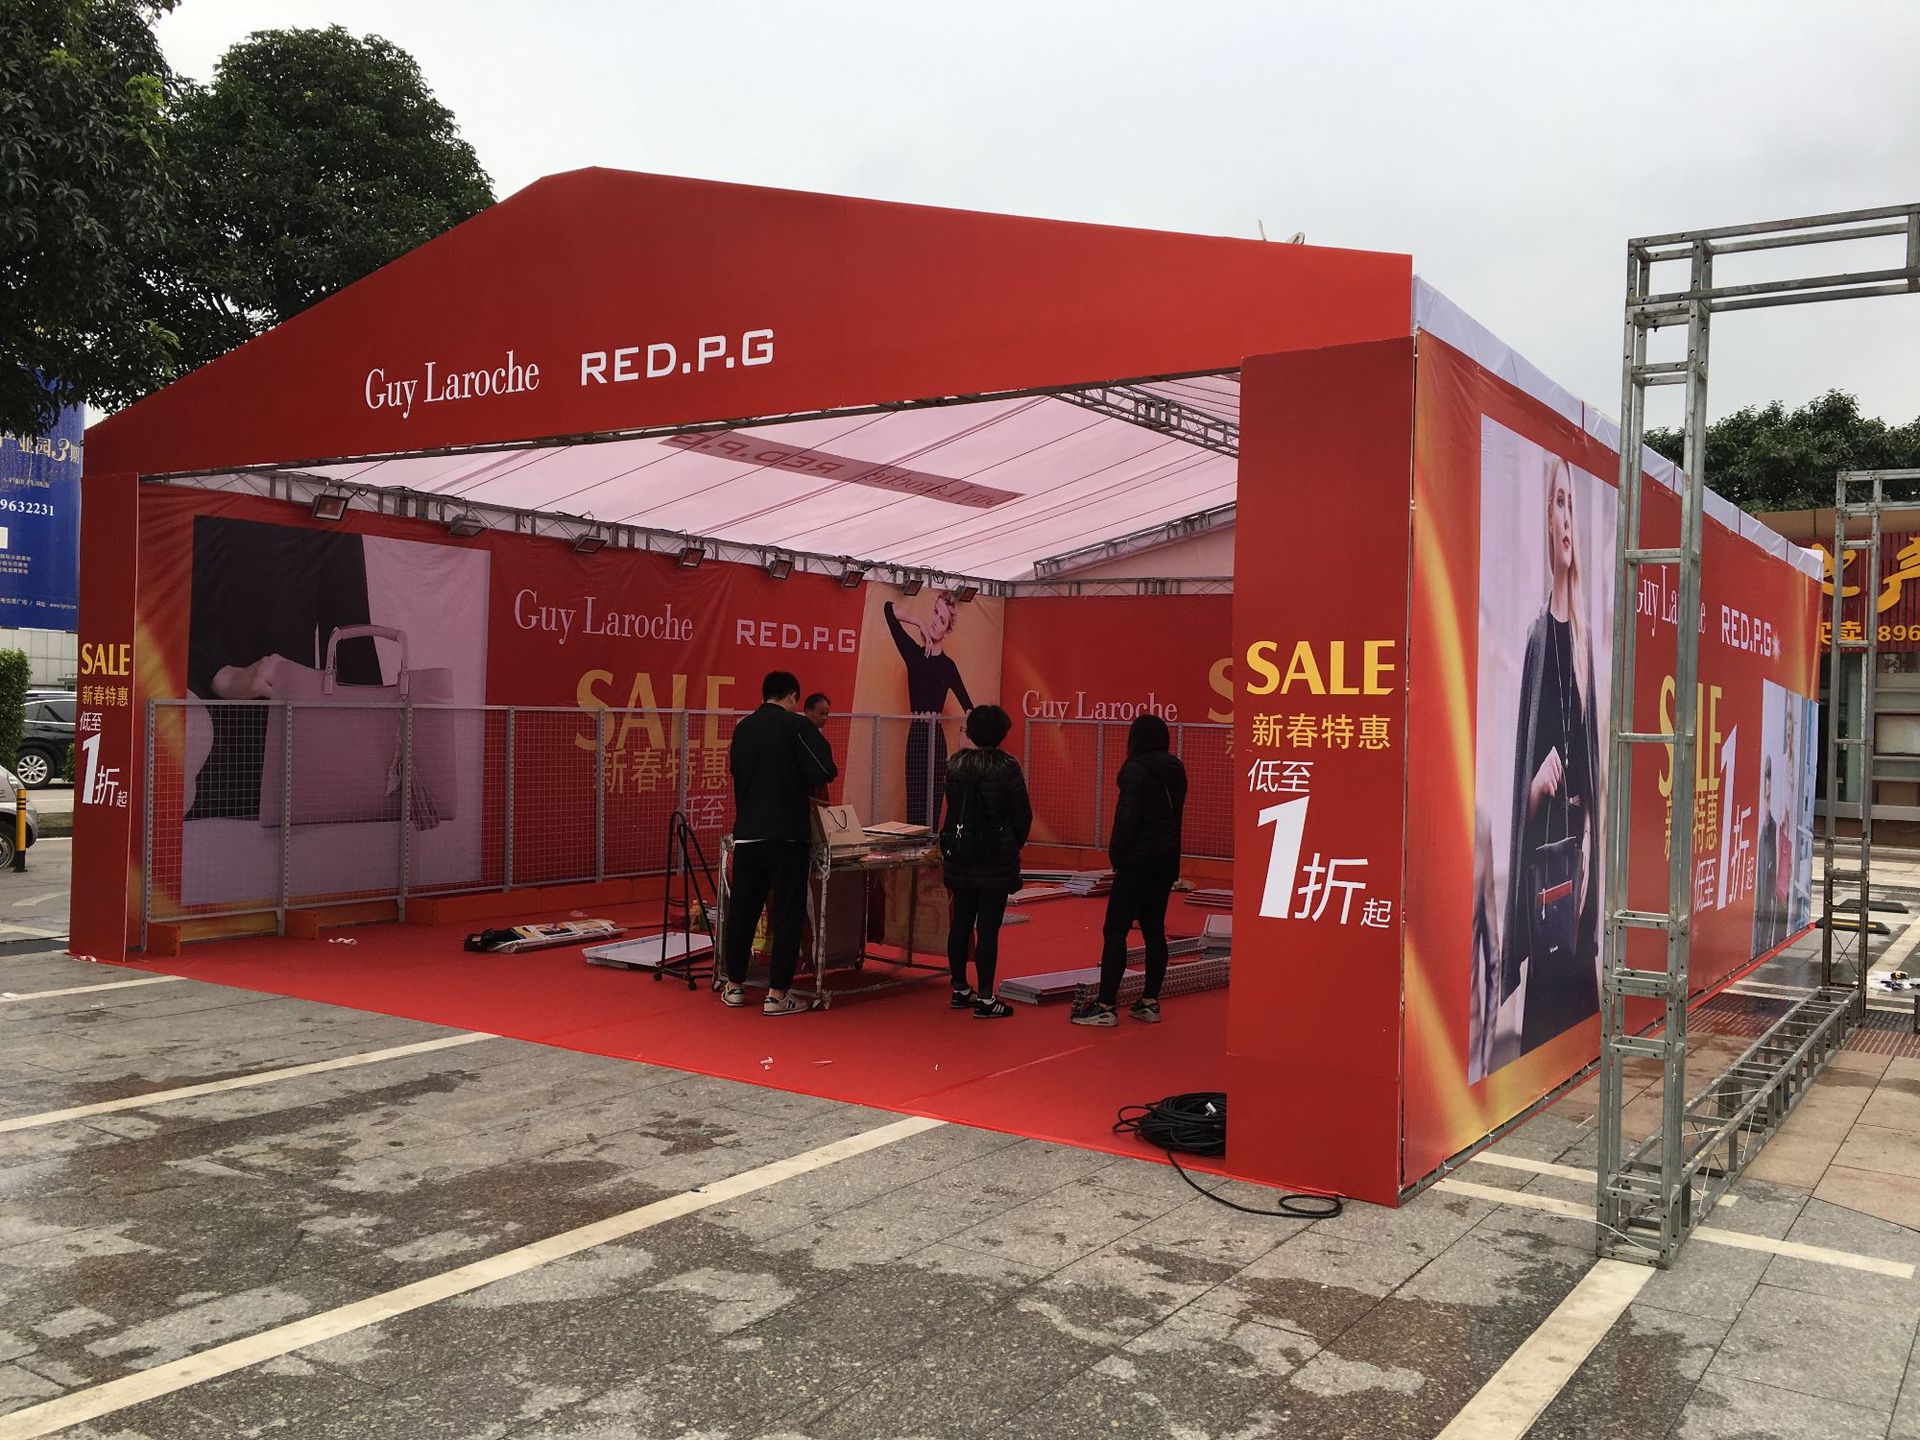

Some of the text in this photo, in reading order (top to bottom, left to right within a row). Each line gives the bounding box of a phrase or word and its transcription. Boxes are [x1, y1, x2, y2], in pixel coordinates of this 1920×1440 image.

[365, 349, 540, 419] Guy Laroche
[580, 328, 775, 387] RED.P.G
[0, 499, 54, 516] 9632231
[514, 588, 694, 645] Guy Laroche
[1636, 564, 1660, 638] uy
[735, 618, 857, 654] RED.P.G
[1721, 604, 1773, 657] RED.P.G
[80, 642, 131, 676] SALE
[1245, 638, 1396, 697] SALE
[79, 710, 103, 732] 低至
[82, 685, 129, 707] 新春特惠
[574, 669, 736, 751] SALE
[1022, 689, 1178, 728] Guy Laroche
[1251, 711, 1392, 751] 新春特惠
[1658, 674, 1723, 798] SLE
[81, 731, 128, 808] 1折起
[1247, 757, 1315, 794] 低至
[1257, 795, 1392, 929] 1折起
